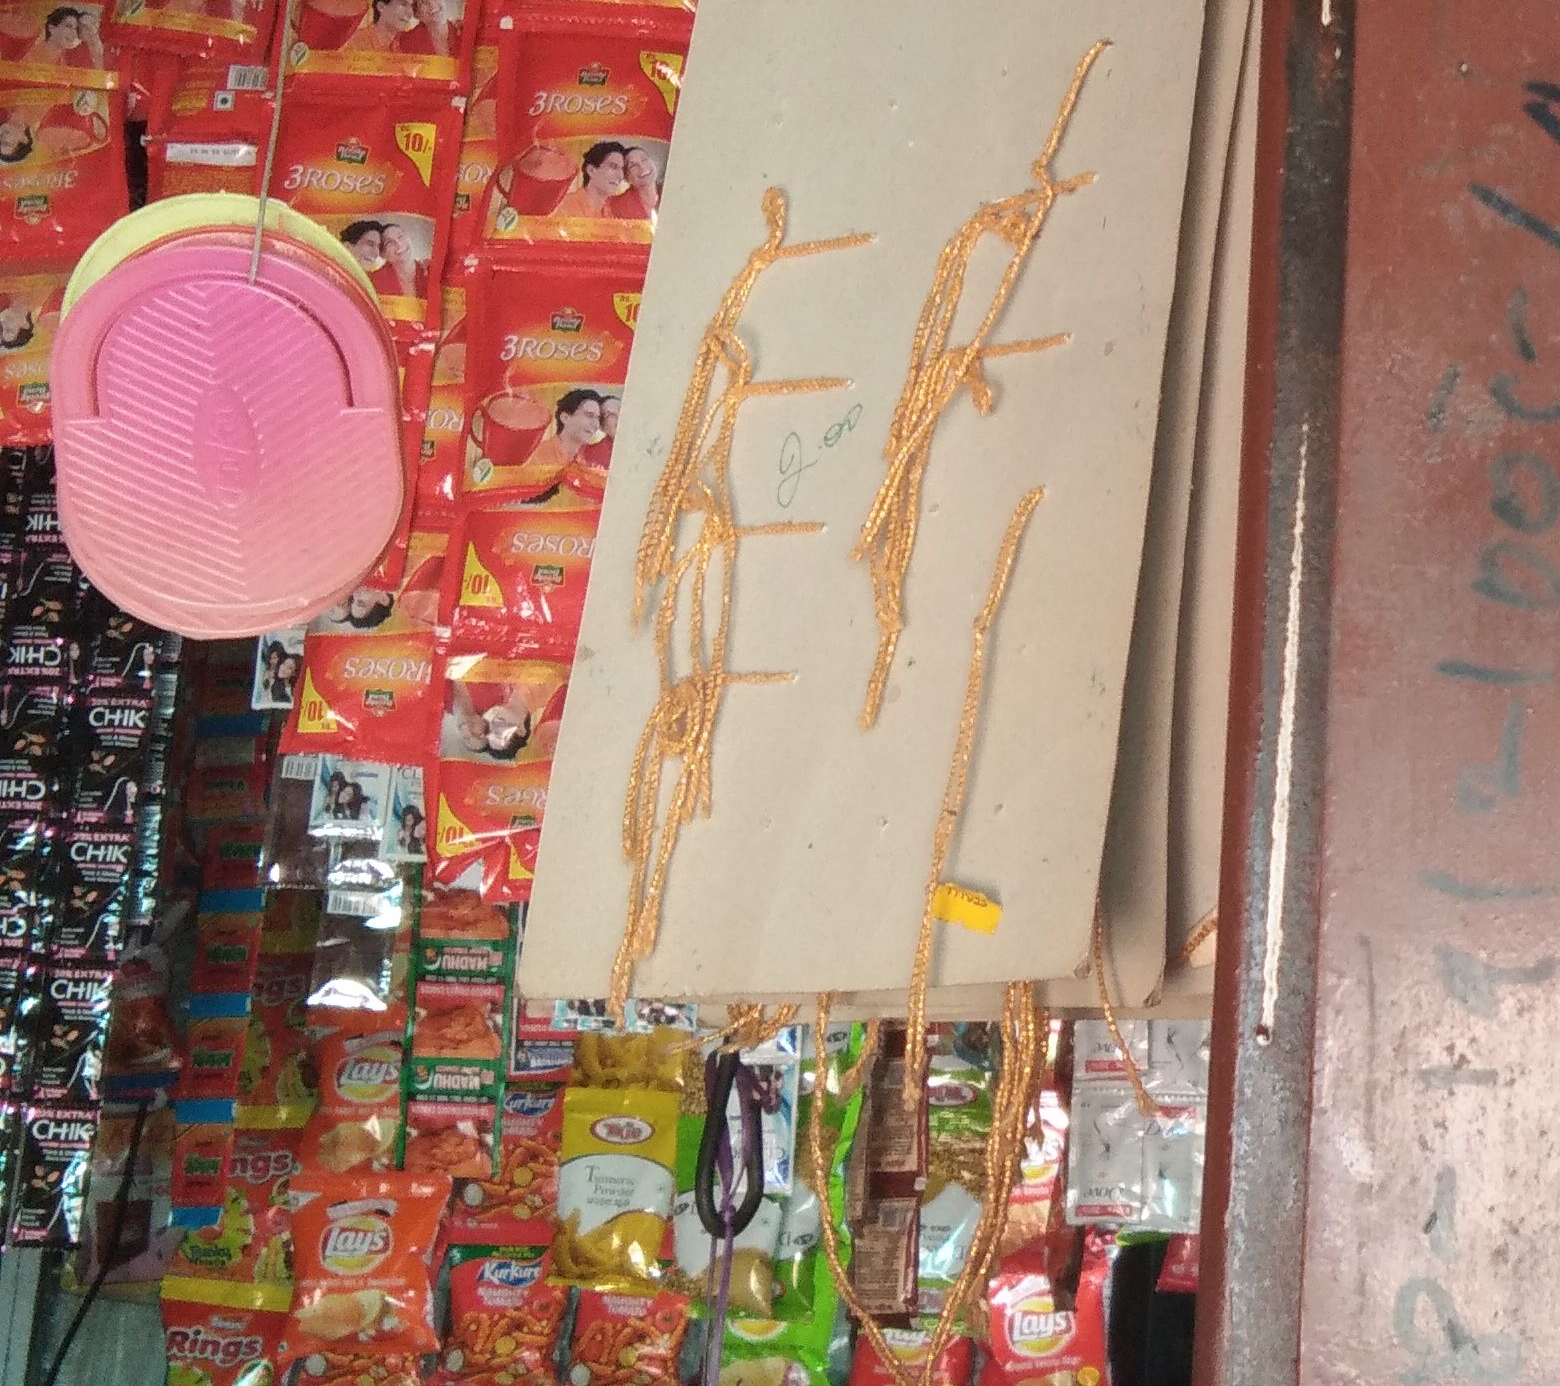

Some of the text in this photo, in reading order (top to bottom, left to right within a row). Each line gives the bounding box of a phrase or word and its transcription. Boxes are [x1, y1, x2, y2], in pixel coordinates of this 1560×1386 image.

[7, 643, 62, 666] CHIK
[88, 706, 148, 729] CHIK
[70, 841, 128, 863] CHIK
[32, 1120, 94, 1141] CHIK
[165, 1328, 263, 1364] Rings
